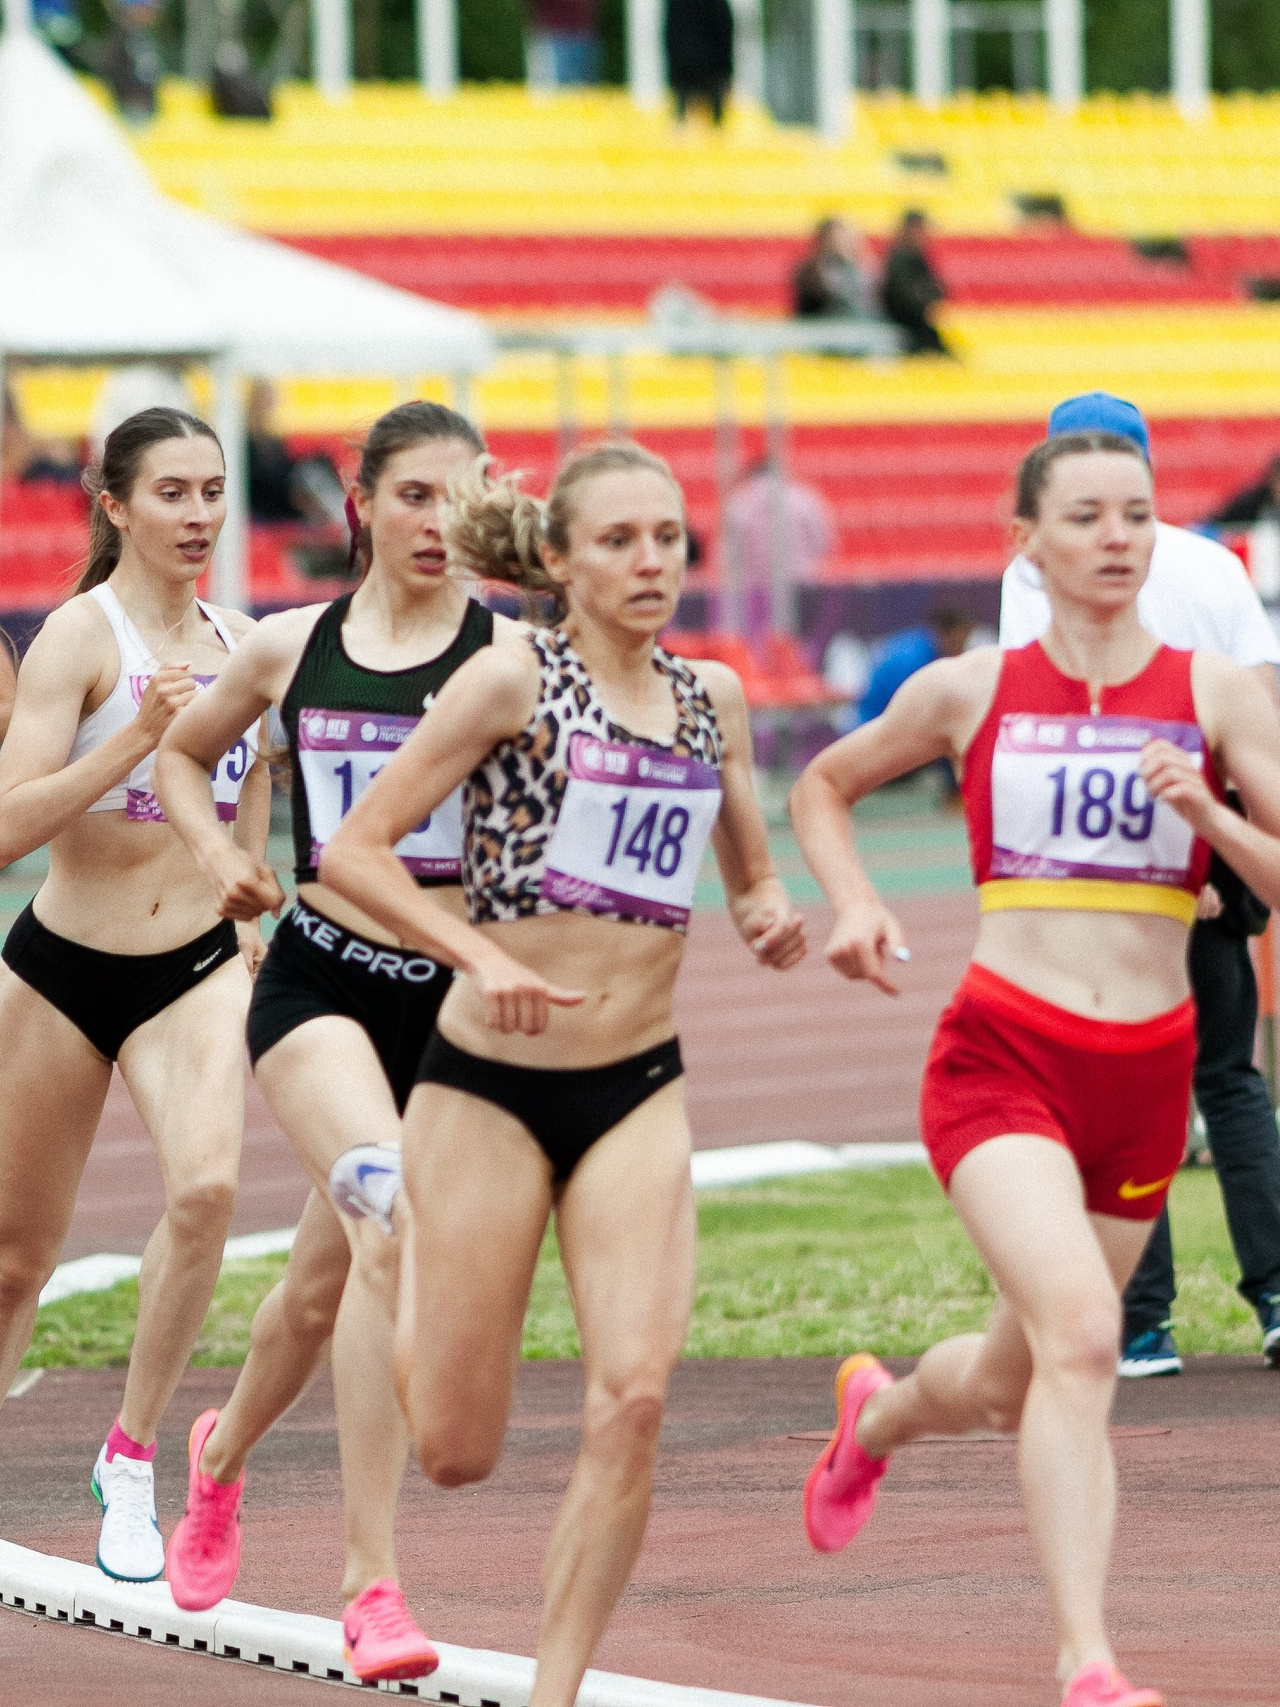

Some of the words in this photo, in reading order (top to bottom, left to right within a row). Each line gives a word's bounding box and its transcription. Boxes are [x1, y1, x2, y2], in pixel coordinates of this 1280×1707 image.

[605, 795, 690, 877] 148
[1047, 766, 1155, 841] 189
[291, 903, 343, 951] IKE
[340, 939, 437, 983] PRO
